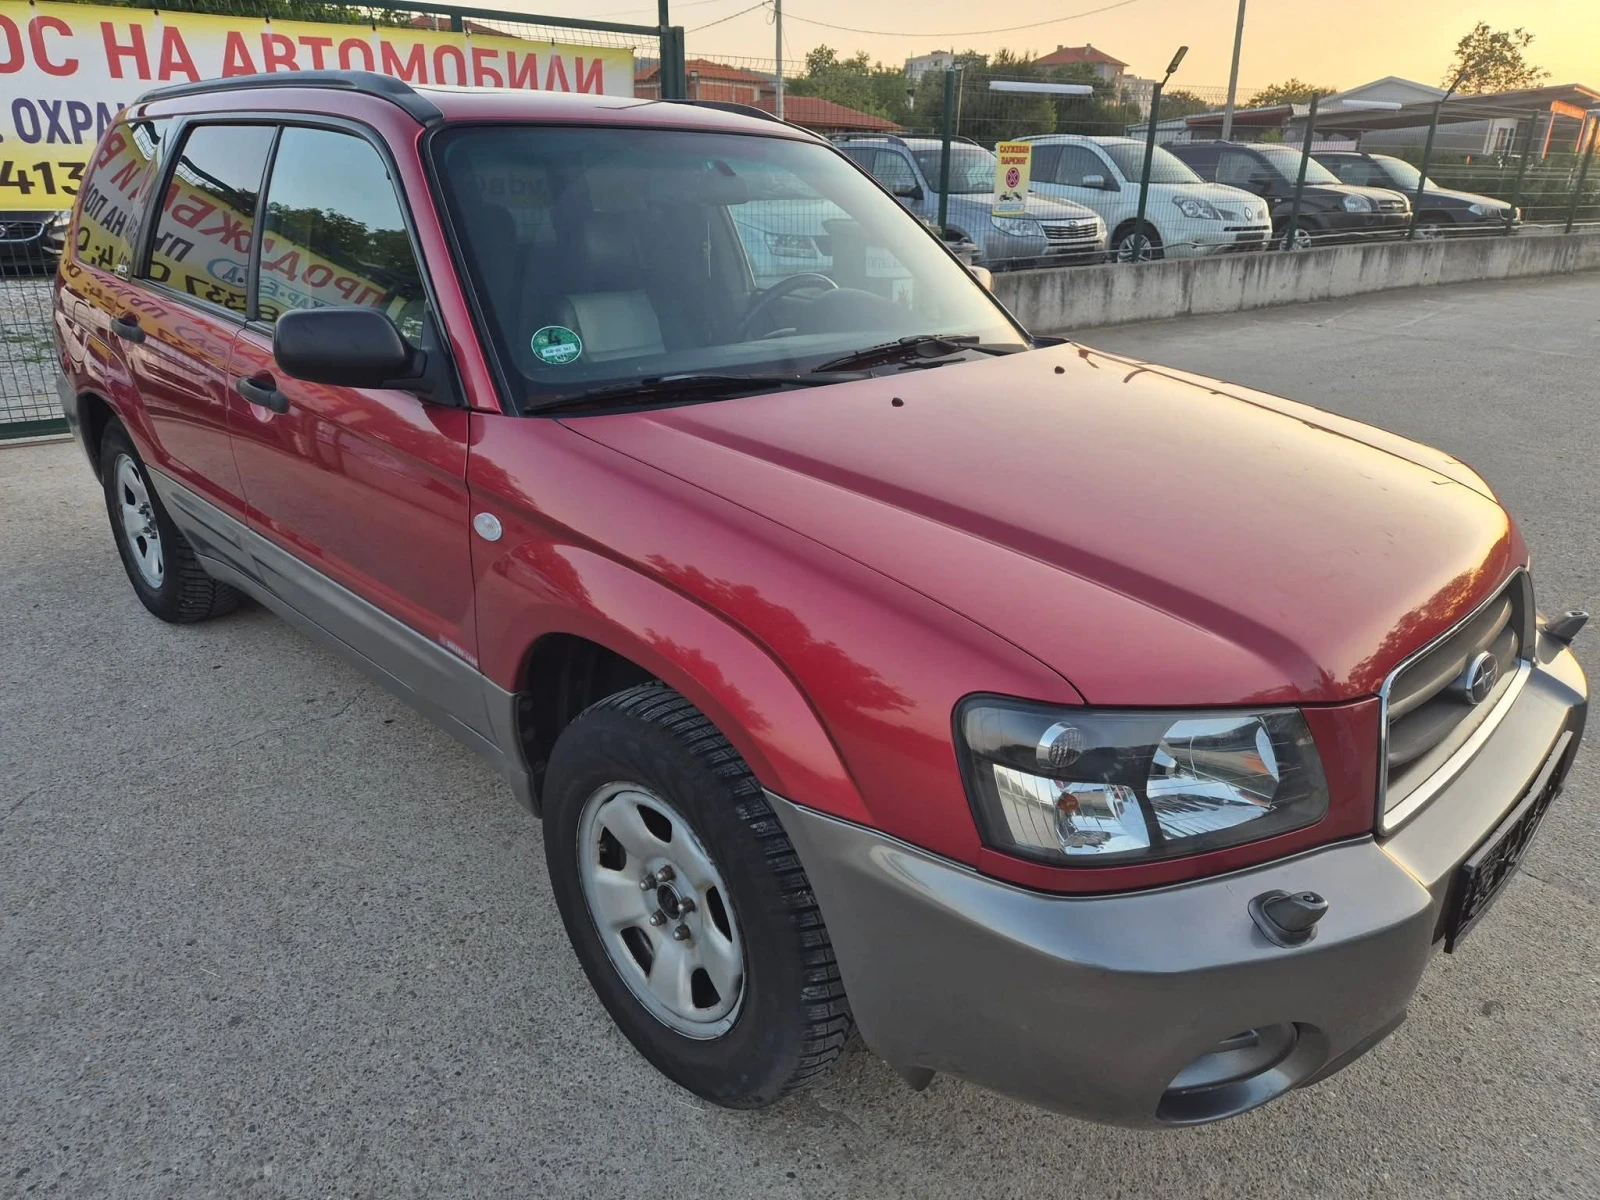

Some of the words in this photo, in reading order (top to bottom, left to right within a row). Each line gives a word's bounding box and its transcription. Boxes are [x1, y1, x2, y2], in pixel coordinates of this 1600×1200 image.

[100, 21, 201, 82] НА
[222, 30, 604, 95] АВТОМОБИЛИ
[1001, 156, 1028, 165] ПАРКИНГ
